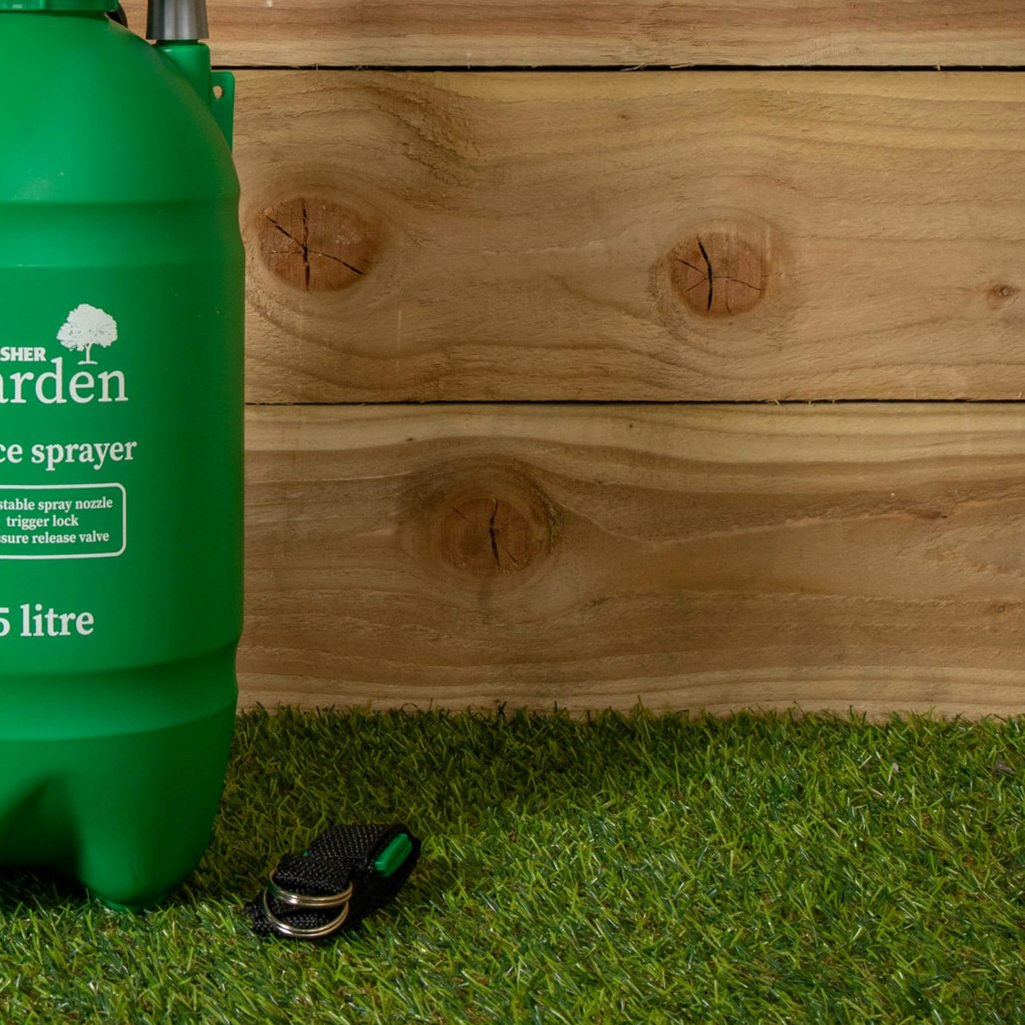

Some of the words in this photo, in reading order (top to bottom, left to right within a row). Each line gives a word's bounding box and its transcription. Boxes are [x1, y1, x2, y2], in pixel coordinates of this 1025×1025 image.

[31, 441, 138, 472] sprayer
[37, 500, 73, 513] spray
[75, 496, 114, 510] nozzle
[6, 515, 50, 531] trigger
[52, 514, 79, 527] lock
[31, 531, 76, 544] release
[78, 530, 110, 543] valve
[20, 603, 95, 637] litre
